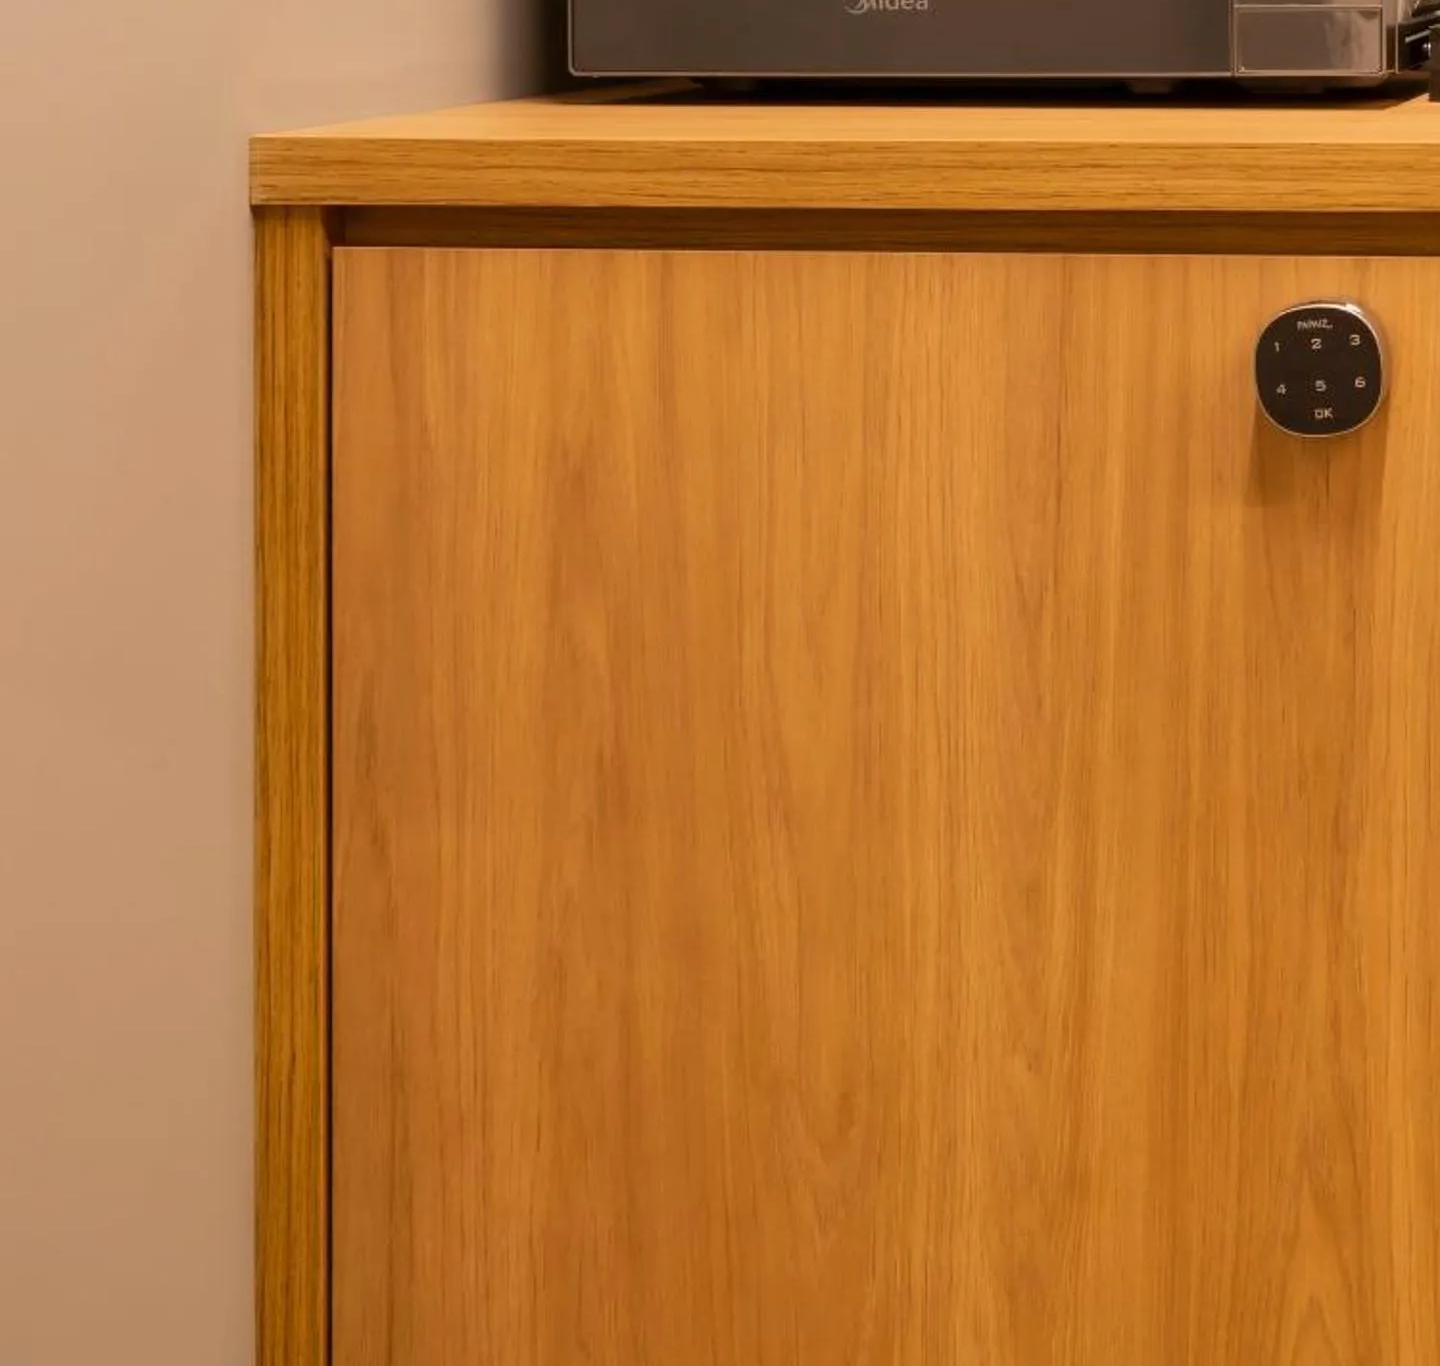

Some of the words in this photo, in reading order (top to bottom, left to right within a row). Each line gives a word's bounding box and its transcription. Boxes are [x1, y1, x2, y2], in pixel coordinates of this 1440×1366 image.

[1274, 341, 1280, 352] 1
[1310, 338, 1322, 350] 2
[1349, 334, 1361, 346] 3
[1276, 384, 1287, 395] 4
[1315, 380, 1327, 392] 5
[1354, 376, 1366, 388] 6
[1314, 408, 1333, 419] OK
